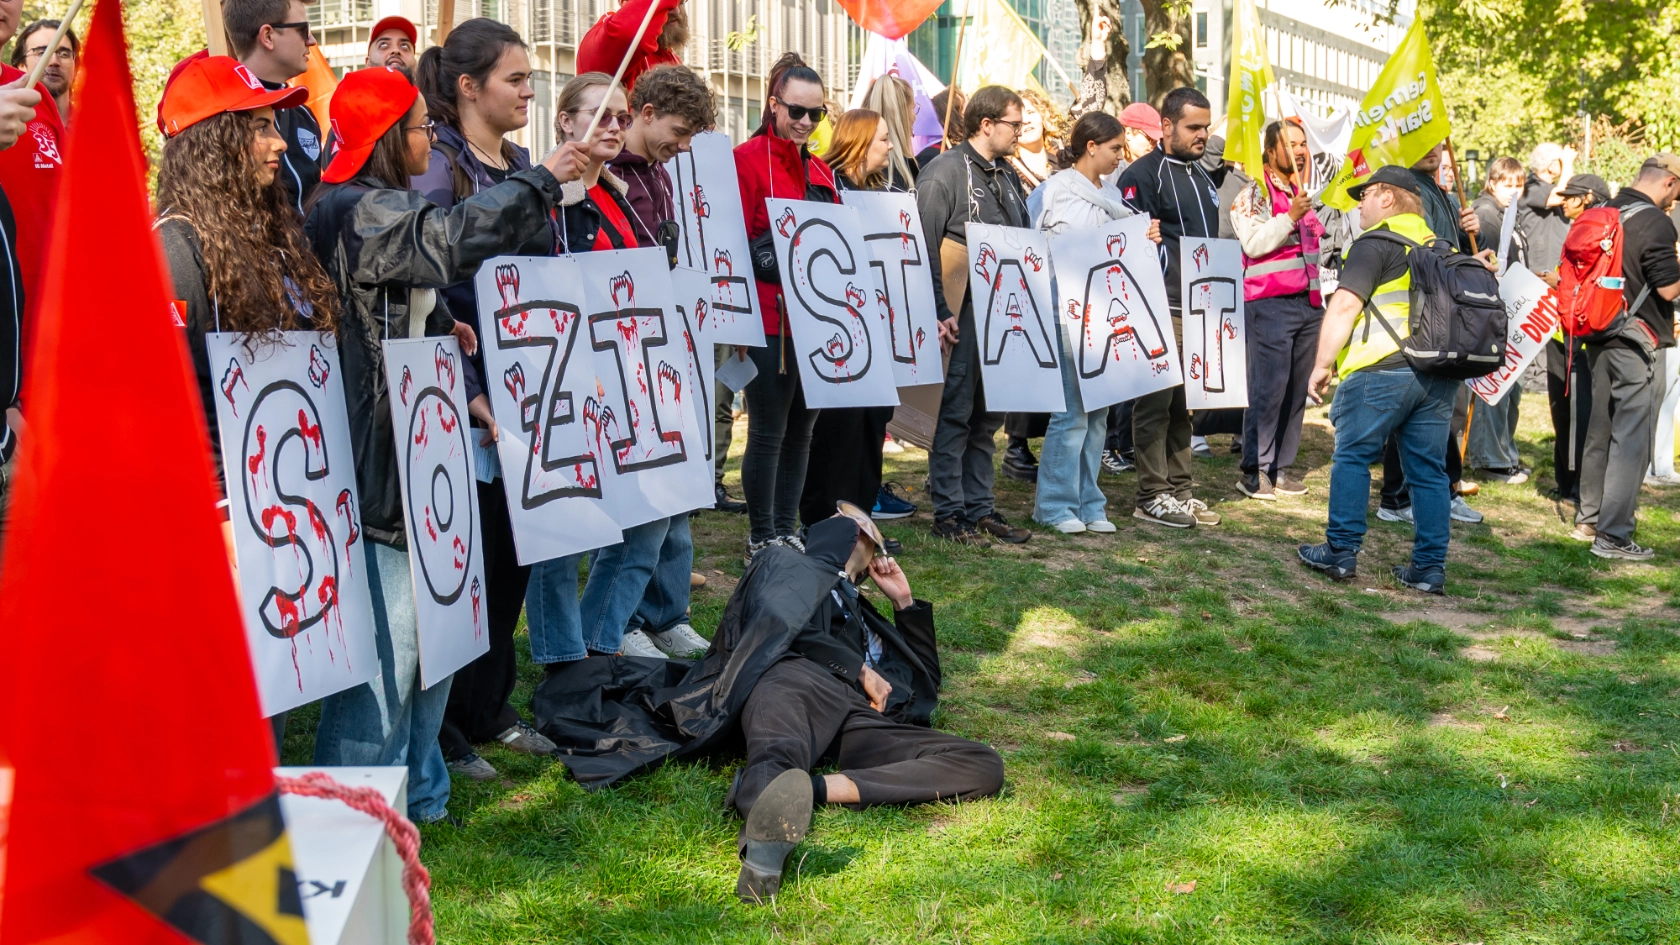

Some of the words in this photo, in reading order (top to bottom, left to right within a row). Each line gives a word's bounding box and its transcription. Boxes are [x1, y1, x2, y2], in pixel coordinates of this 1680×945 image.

[789, 217, 873, 384] S
[864, 232, 922, 364] T
[983, 259, 1059, 369] A
[1080, 260, 1169, 379] A
[1189, 276, 1237, 393] T
[1508, 330, 1527, 345] ist
[494, 300, 603, 510] Z
[589, 308, 687, 475] I
[242, 379, 339, 639] S
[406, 386, 473, 605] O
